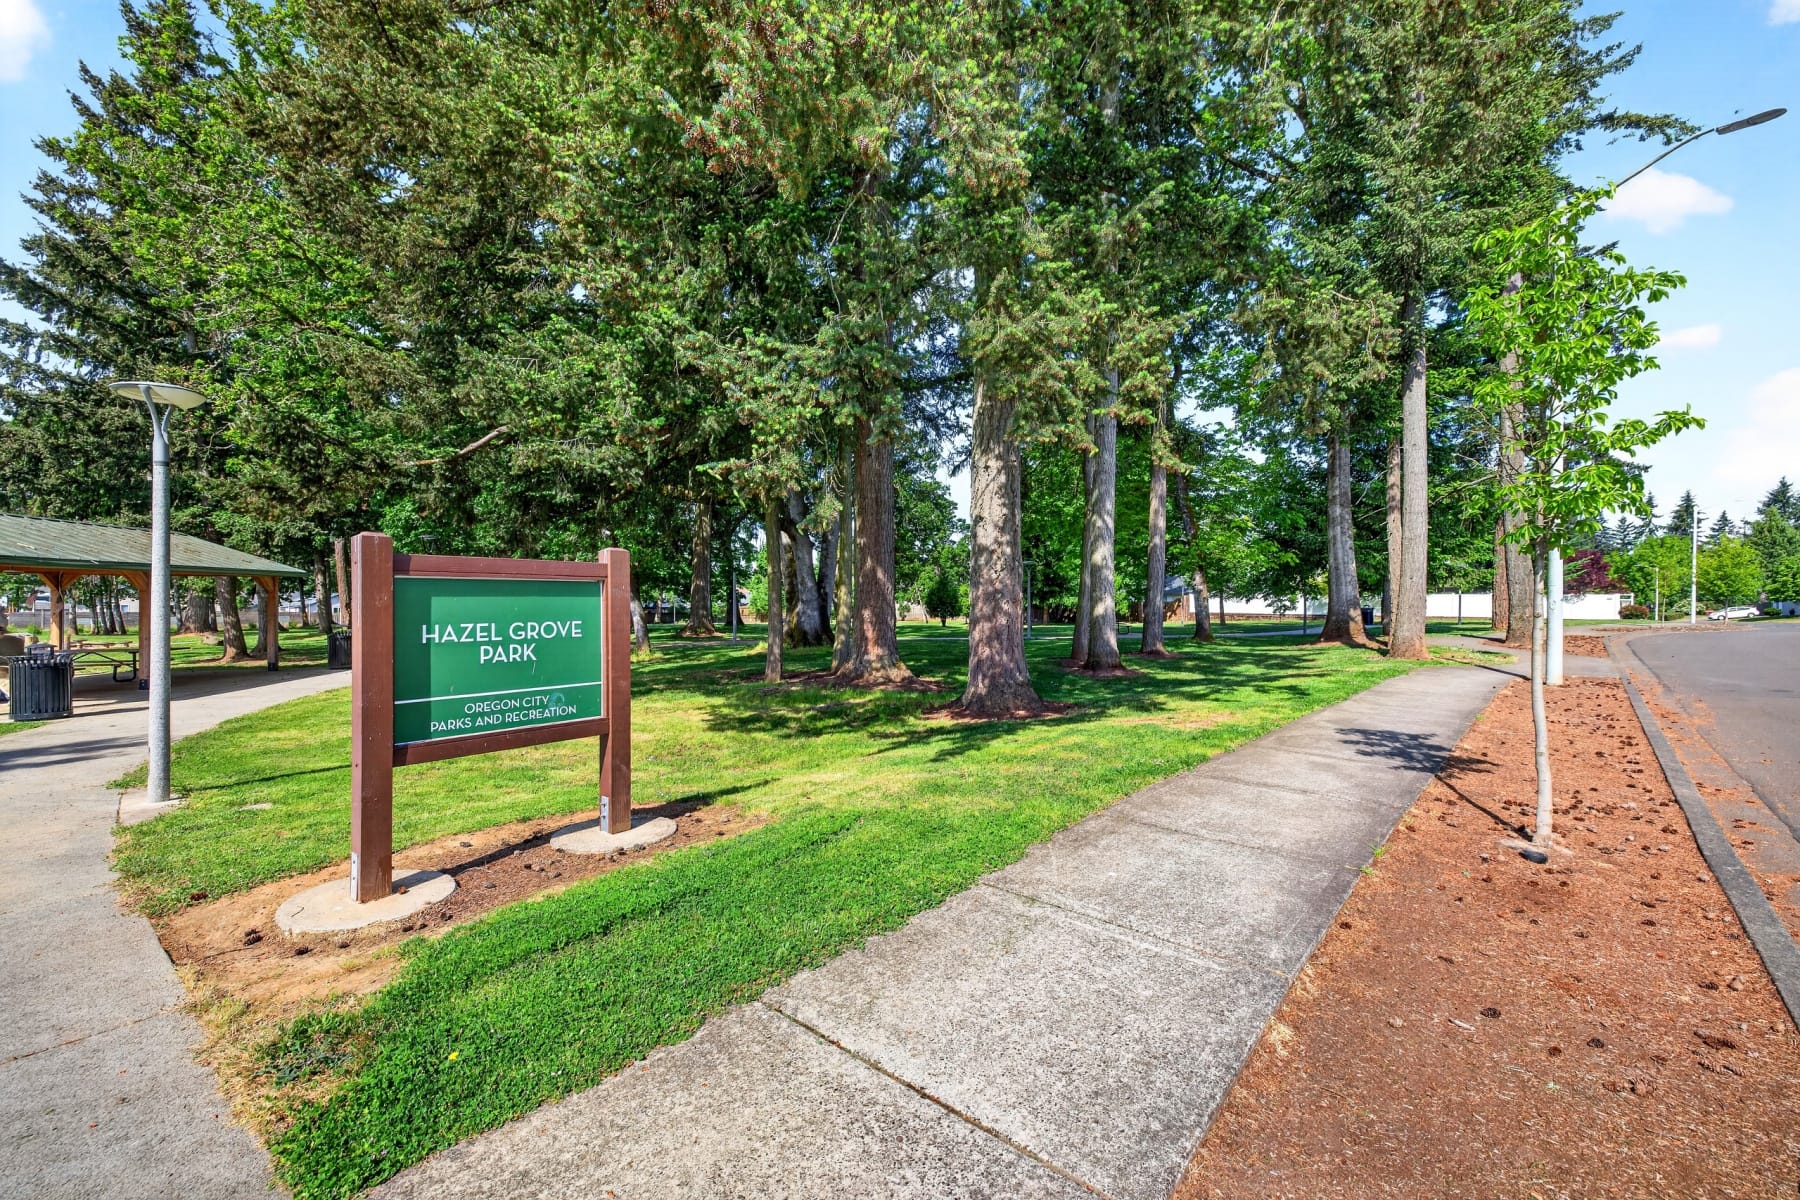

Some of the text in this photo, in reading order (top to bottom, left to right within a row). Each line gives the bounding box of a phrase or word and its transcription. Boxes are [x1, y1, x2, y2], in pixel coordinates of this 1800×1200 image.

[422, 620, 582, 644] HAZEL GROVE
[480, 643, 537, 664] PARK
[465, 695, 550, 714] OREGON CITY
[430, 705, 577, 732] PARKS AND RECREATION
